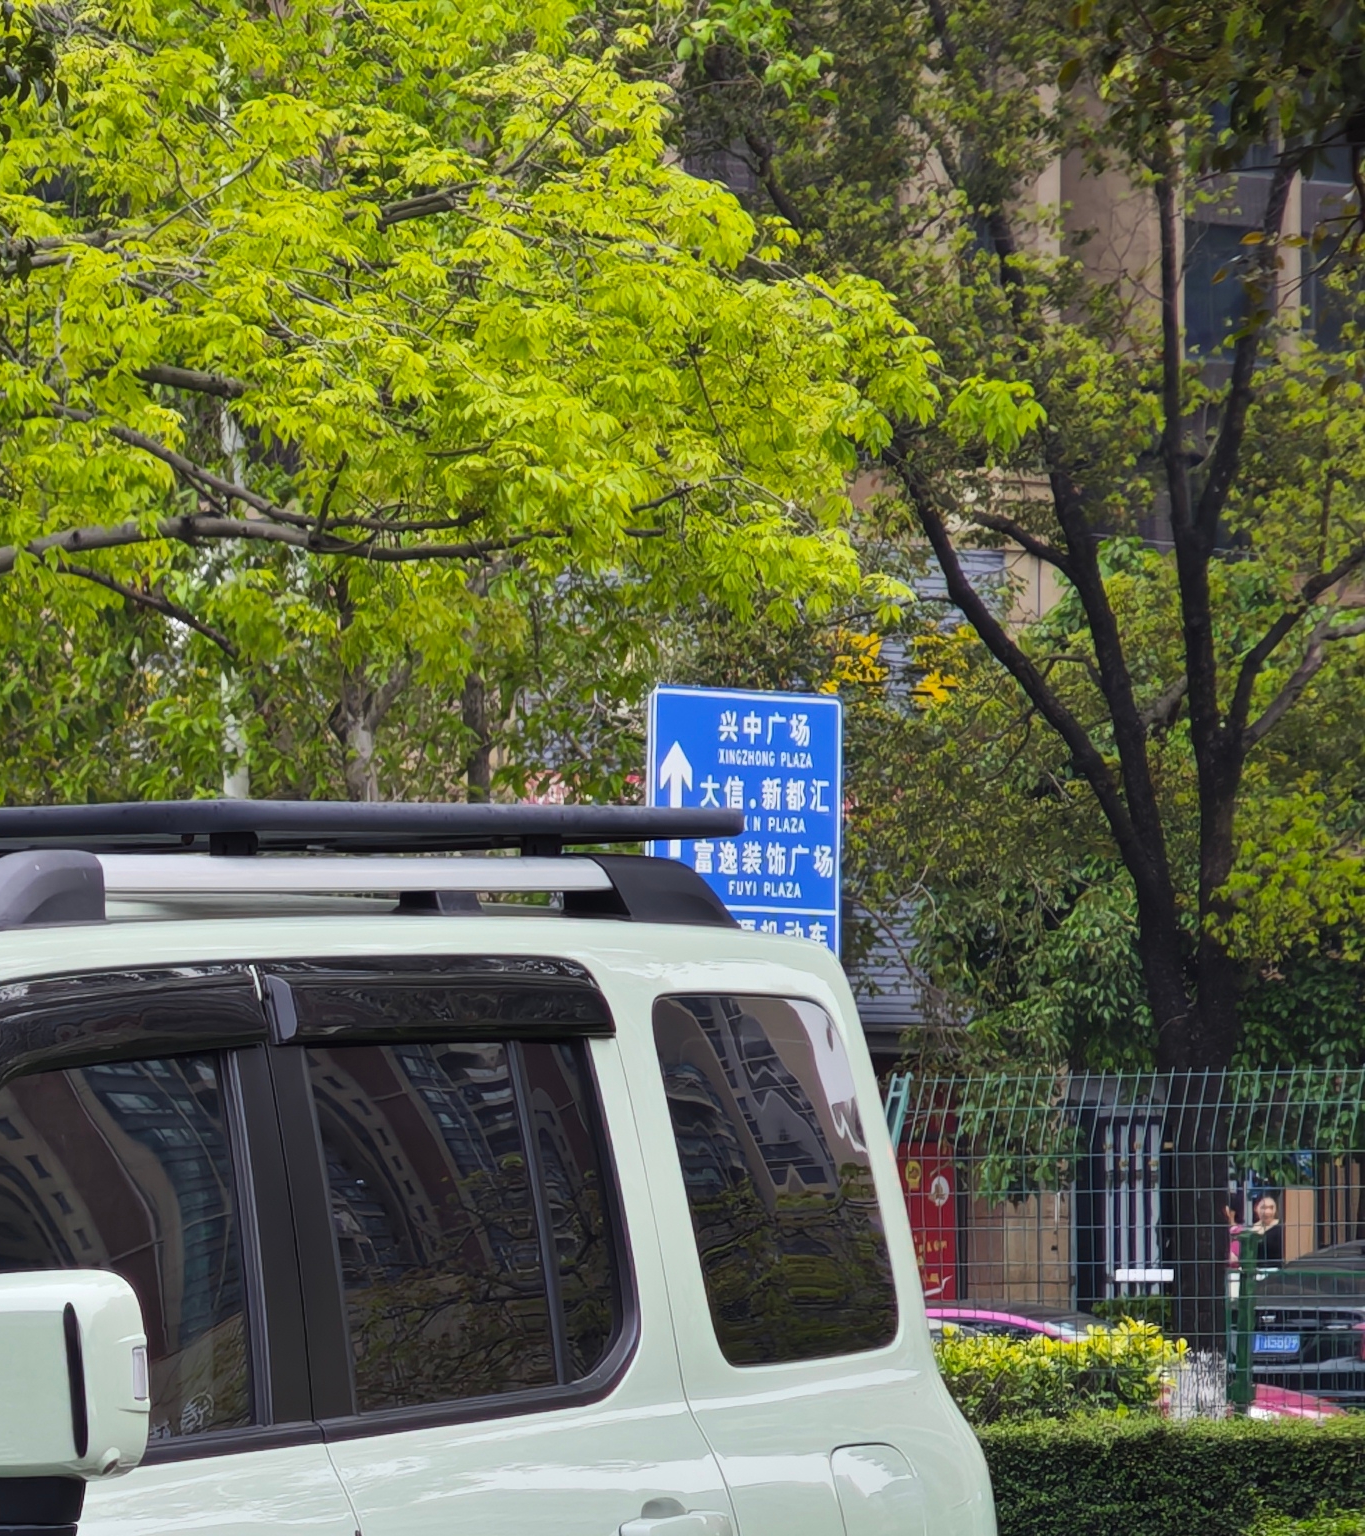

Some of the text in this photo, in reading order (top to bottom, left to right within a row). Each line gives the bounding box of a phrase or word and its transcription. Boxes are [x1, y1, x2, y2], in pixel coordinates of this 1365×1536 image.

[718, 710, 810, 747] 兴中广场
[719, 749, 813, 769] XINGZHONG PLAZA
[768, 816, 806, 834] PLAZA
[694, 839, 834, 878] 富逸装饰广场
[728, 880, 802, 898] FUYI PLAZA
